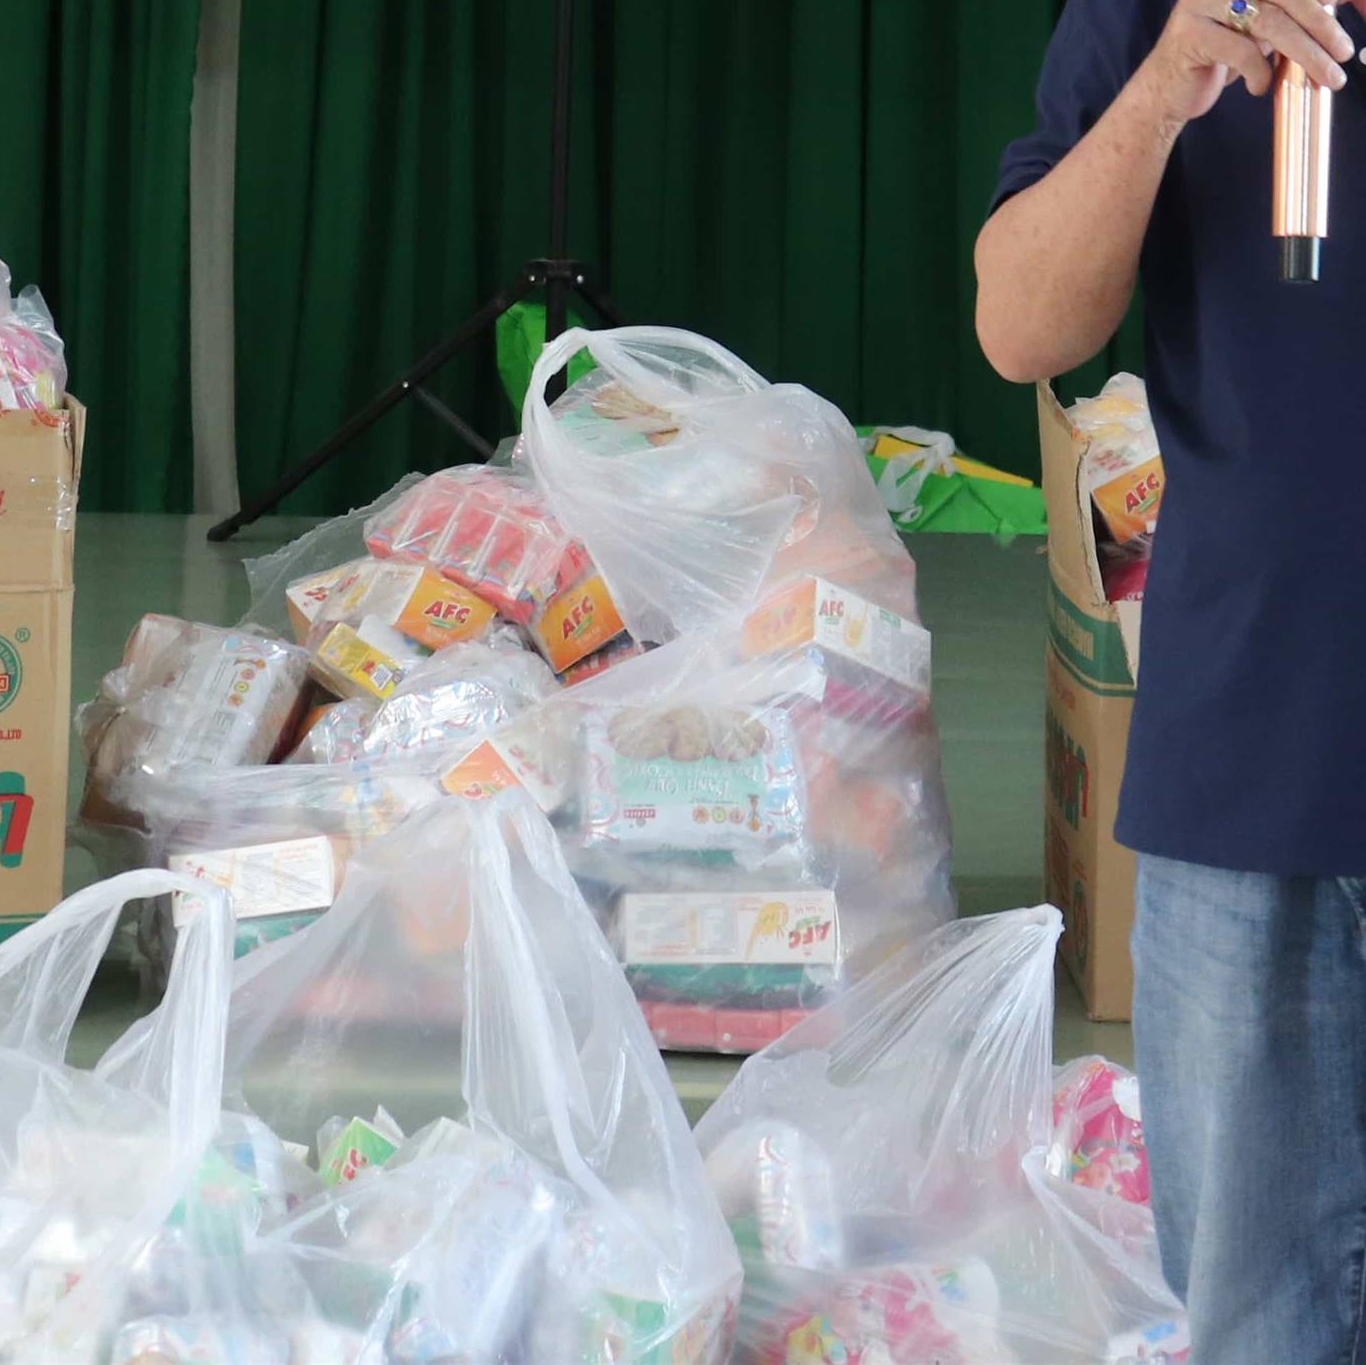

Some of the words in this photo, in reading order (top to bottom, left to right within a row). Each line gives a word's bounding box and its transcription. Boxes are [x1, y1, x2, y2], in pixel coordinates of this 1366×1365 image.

[1125, 472, 1161, 514] AFC
[424, 601, 473, 625] AFC
[561, 596, 595, 641] AFC
[819, 600, 844, 616] AFC
[789, 921, 832, 949] AFC
